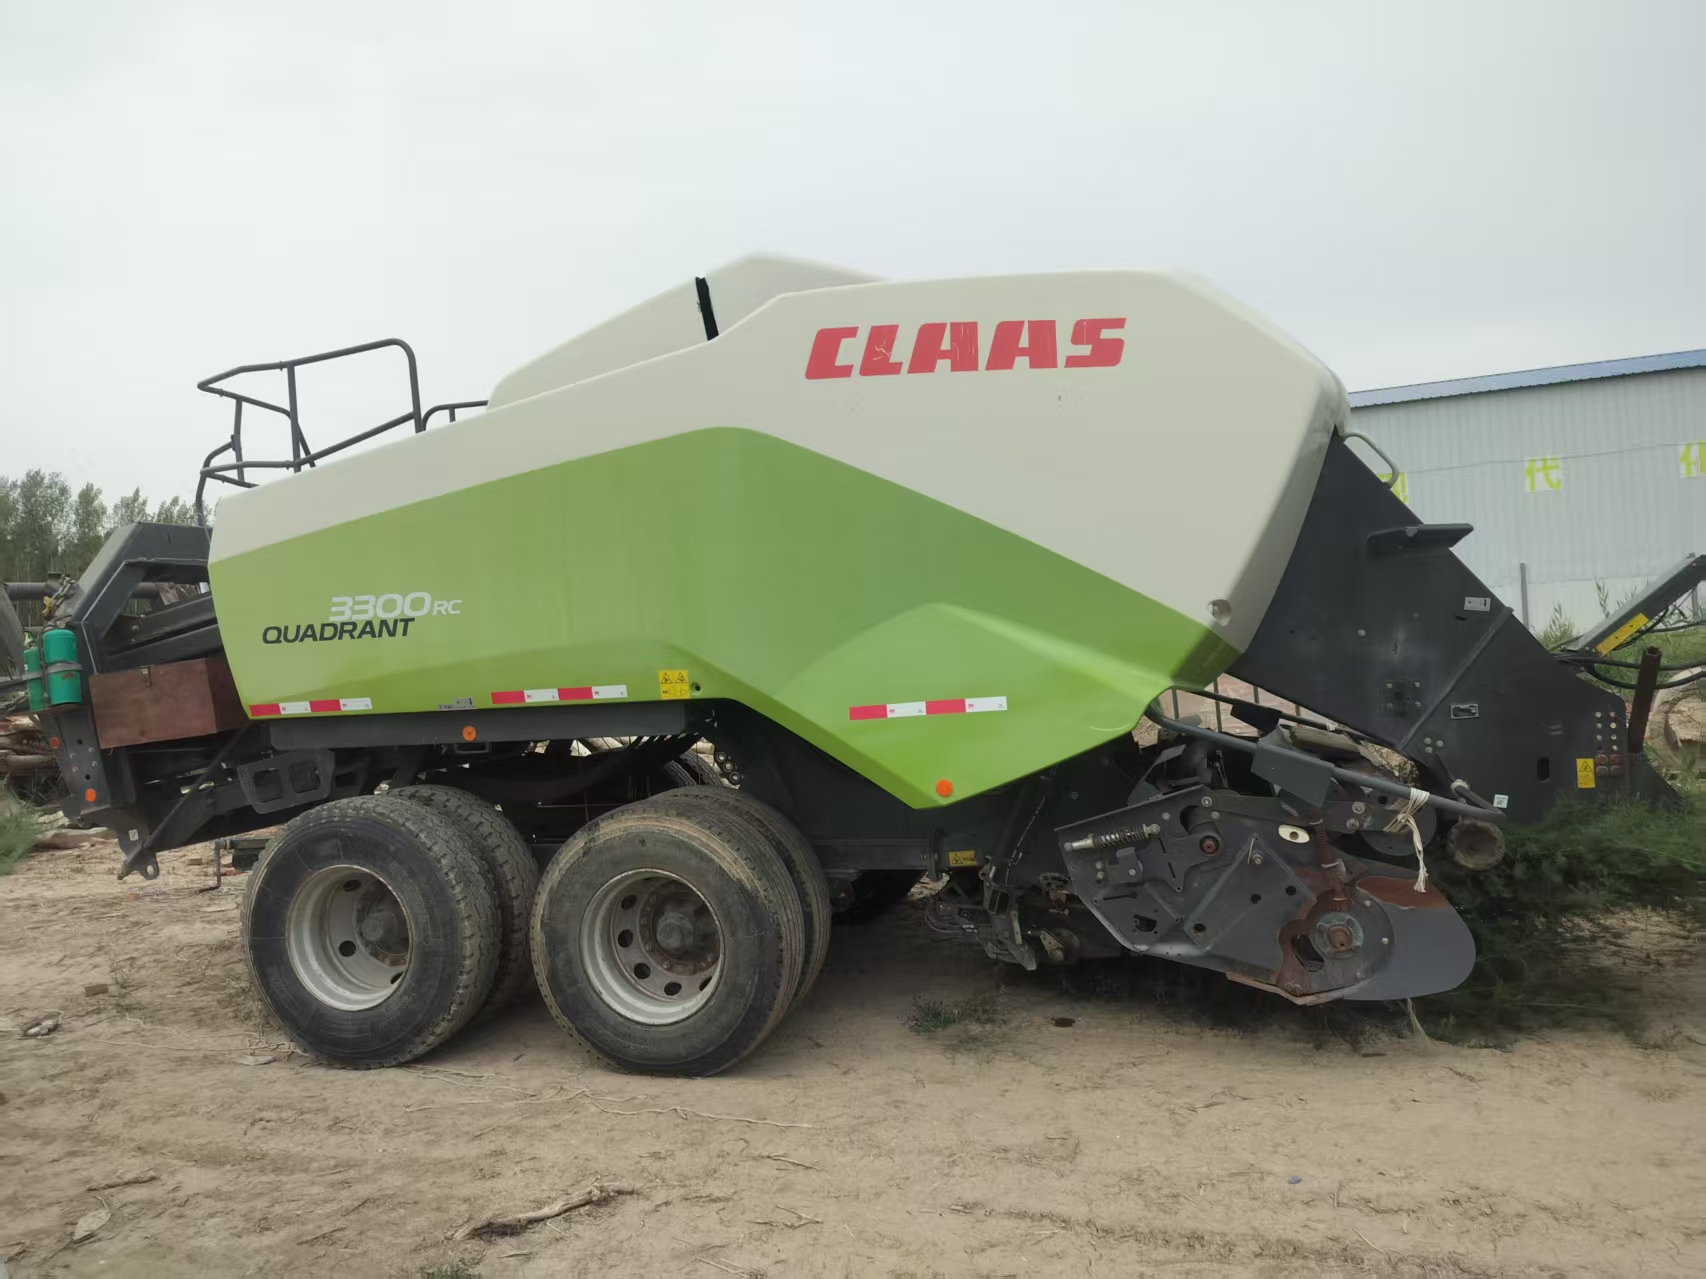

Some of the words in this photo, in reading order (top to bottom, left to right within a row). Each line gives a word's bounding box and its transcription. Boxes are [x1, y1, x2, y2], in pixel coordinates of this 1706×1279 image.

[805, 317, 1127, 380] CLAAS
[1524, 457, 1562, 493] 代
[329, 592, 431, 622] 3300
[432, 599, 463, 616] RC
[262, 617, 416, 645] QUADRANT
